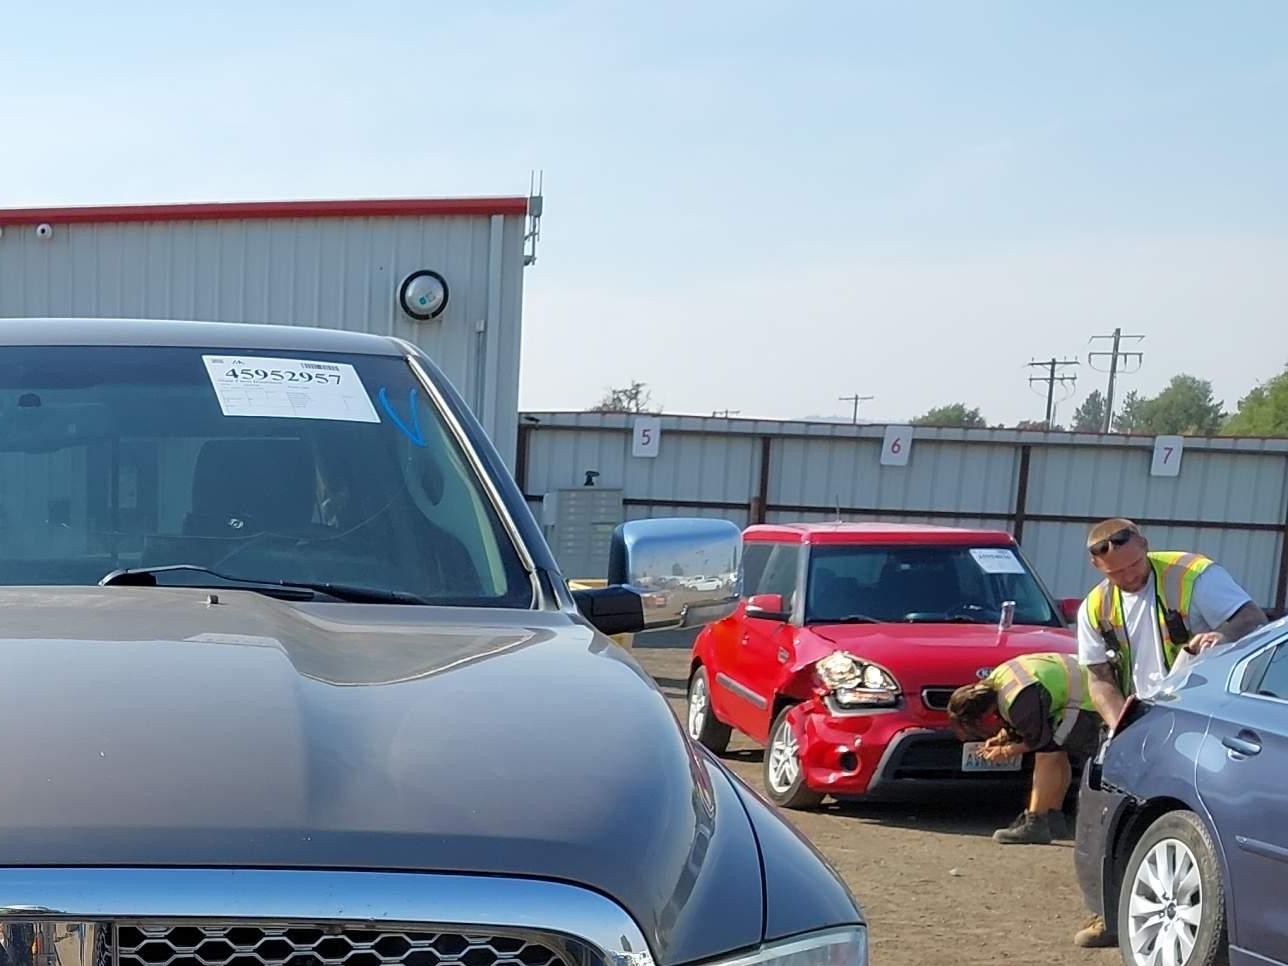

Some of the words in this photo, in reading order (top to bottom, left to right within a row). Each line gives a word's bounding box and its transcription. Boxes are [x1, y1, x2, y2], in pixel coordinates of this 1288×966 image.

[225, 368, 342, 385] 45952957
[641, 428, 652, 446] 5
[891, 437, 902, 454] 6
[1163, 446, 1174, 465] 7
